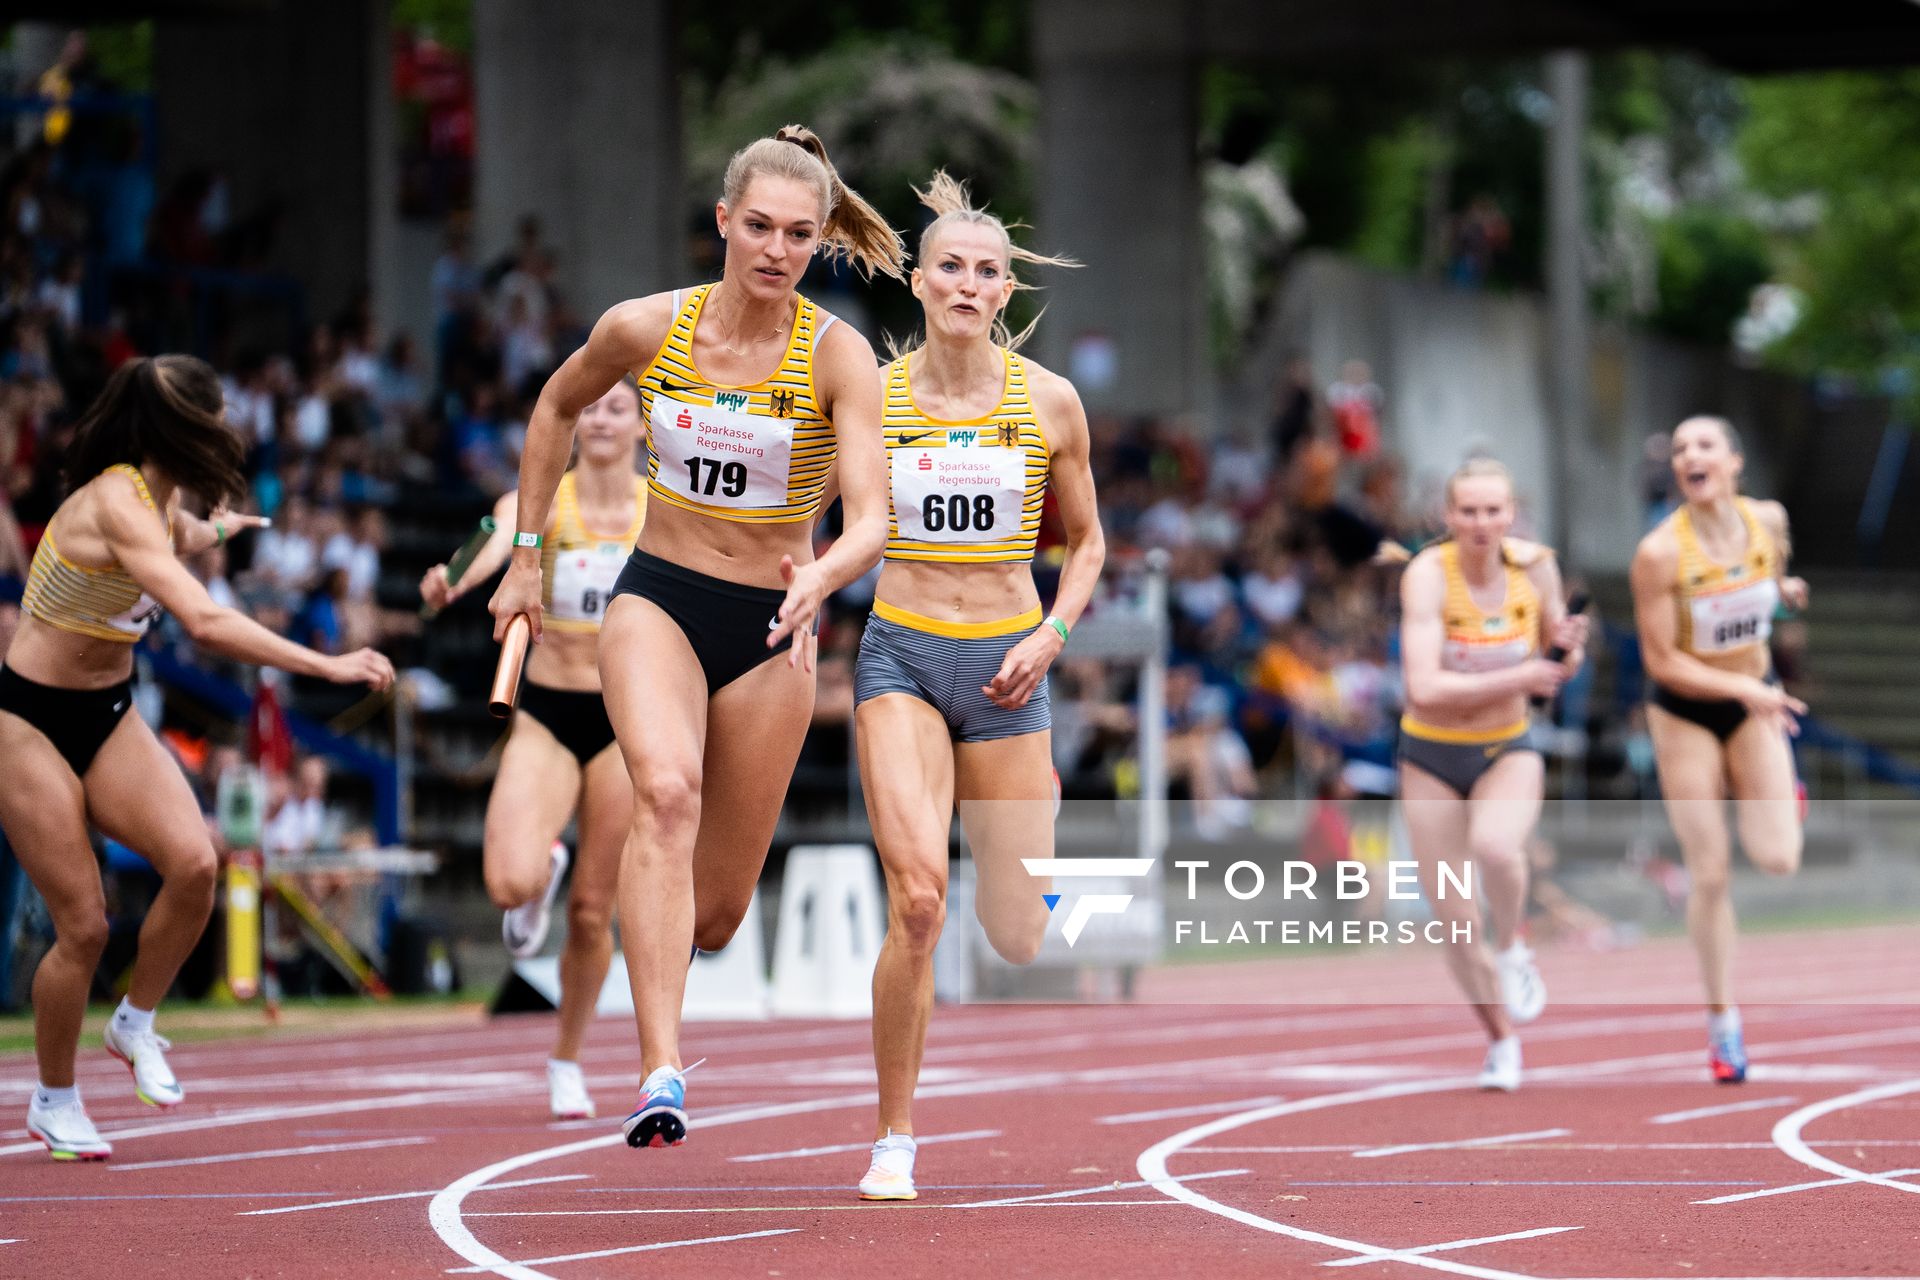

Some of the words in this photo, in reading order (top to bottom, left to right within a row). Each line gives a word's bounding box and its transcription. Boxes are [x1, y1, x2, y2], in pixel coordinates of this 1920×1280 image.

[698, 421, 754, 441] Sparkasse
[696, 436, 764, 458] Regensburg
[683, 456, 748, 498] 179
[938, 461, 991, 473] Sparkasse
[938, 474, 1001, 486] Regensburg
[923, 494, 995, 532] 608
